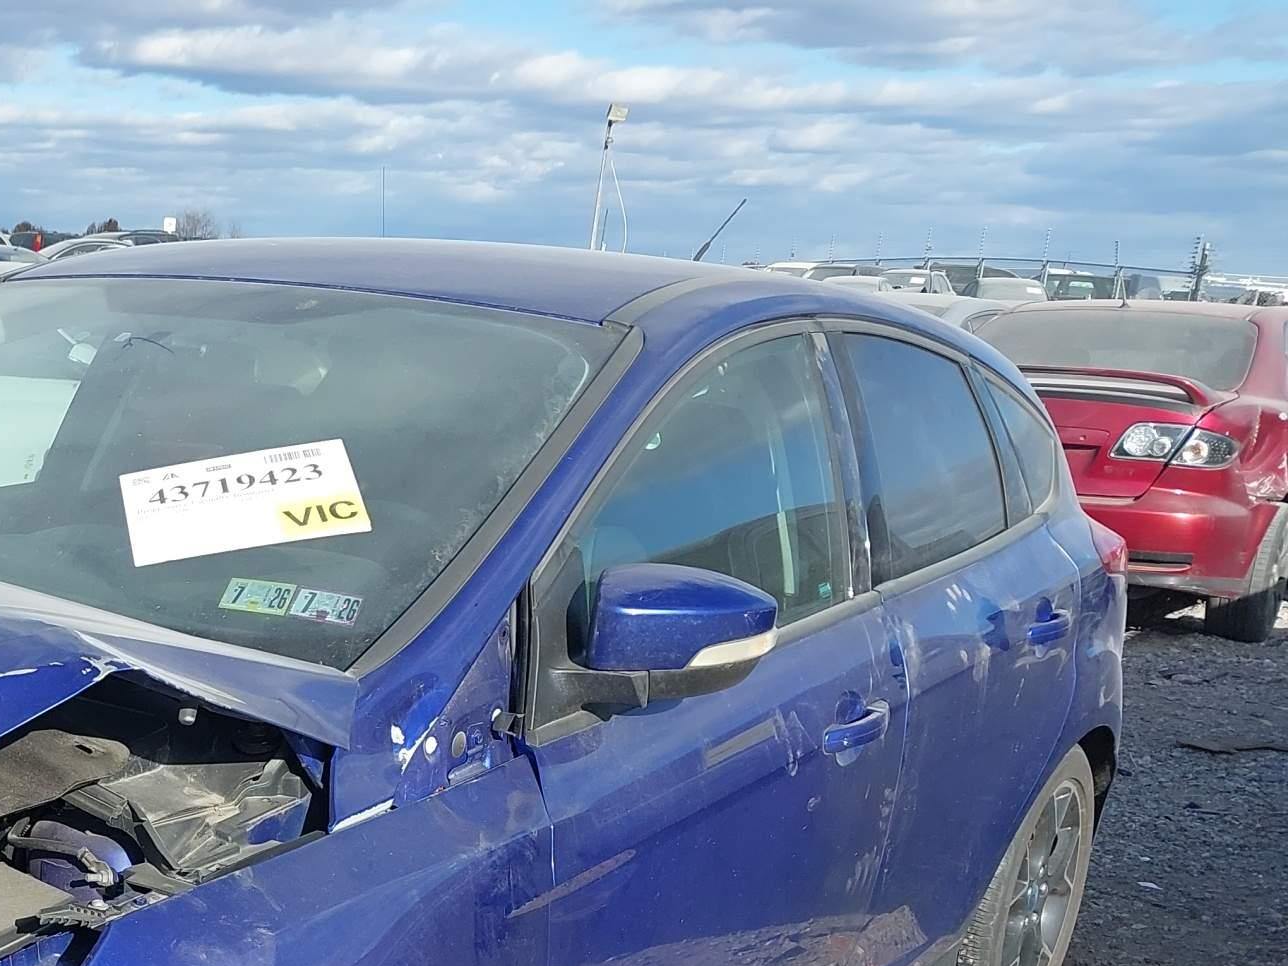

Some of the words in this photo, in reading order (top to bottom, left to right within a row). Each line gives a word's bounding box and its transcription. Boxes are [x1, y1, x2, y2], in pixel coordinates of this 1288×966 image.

[148, 463, 324, 505] 43719423
[282, 500, 359, 527] VIC
[268, 587, 292, 610] 26
[336, 597, 361, 621] 26
